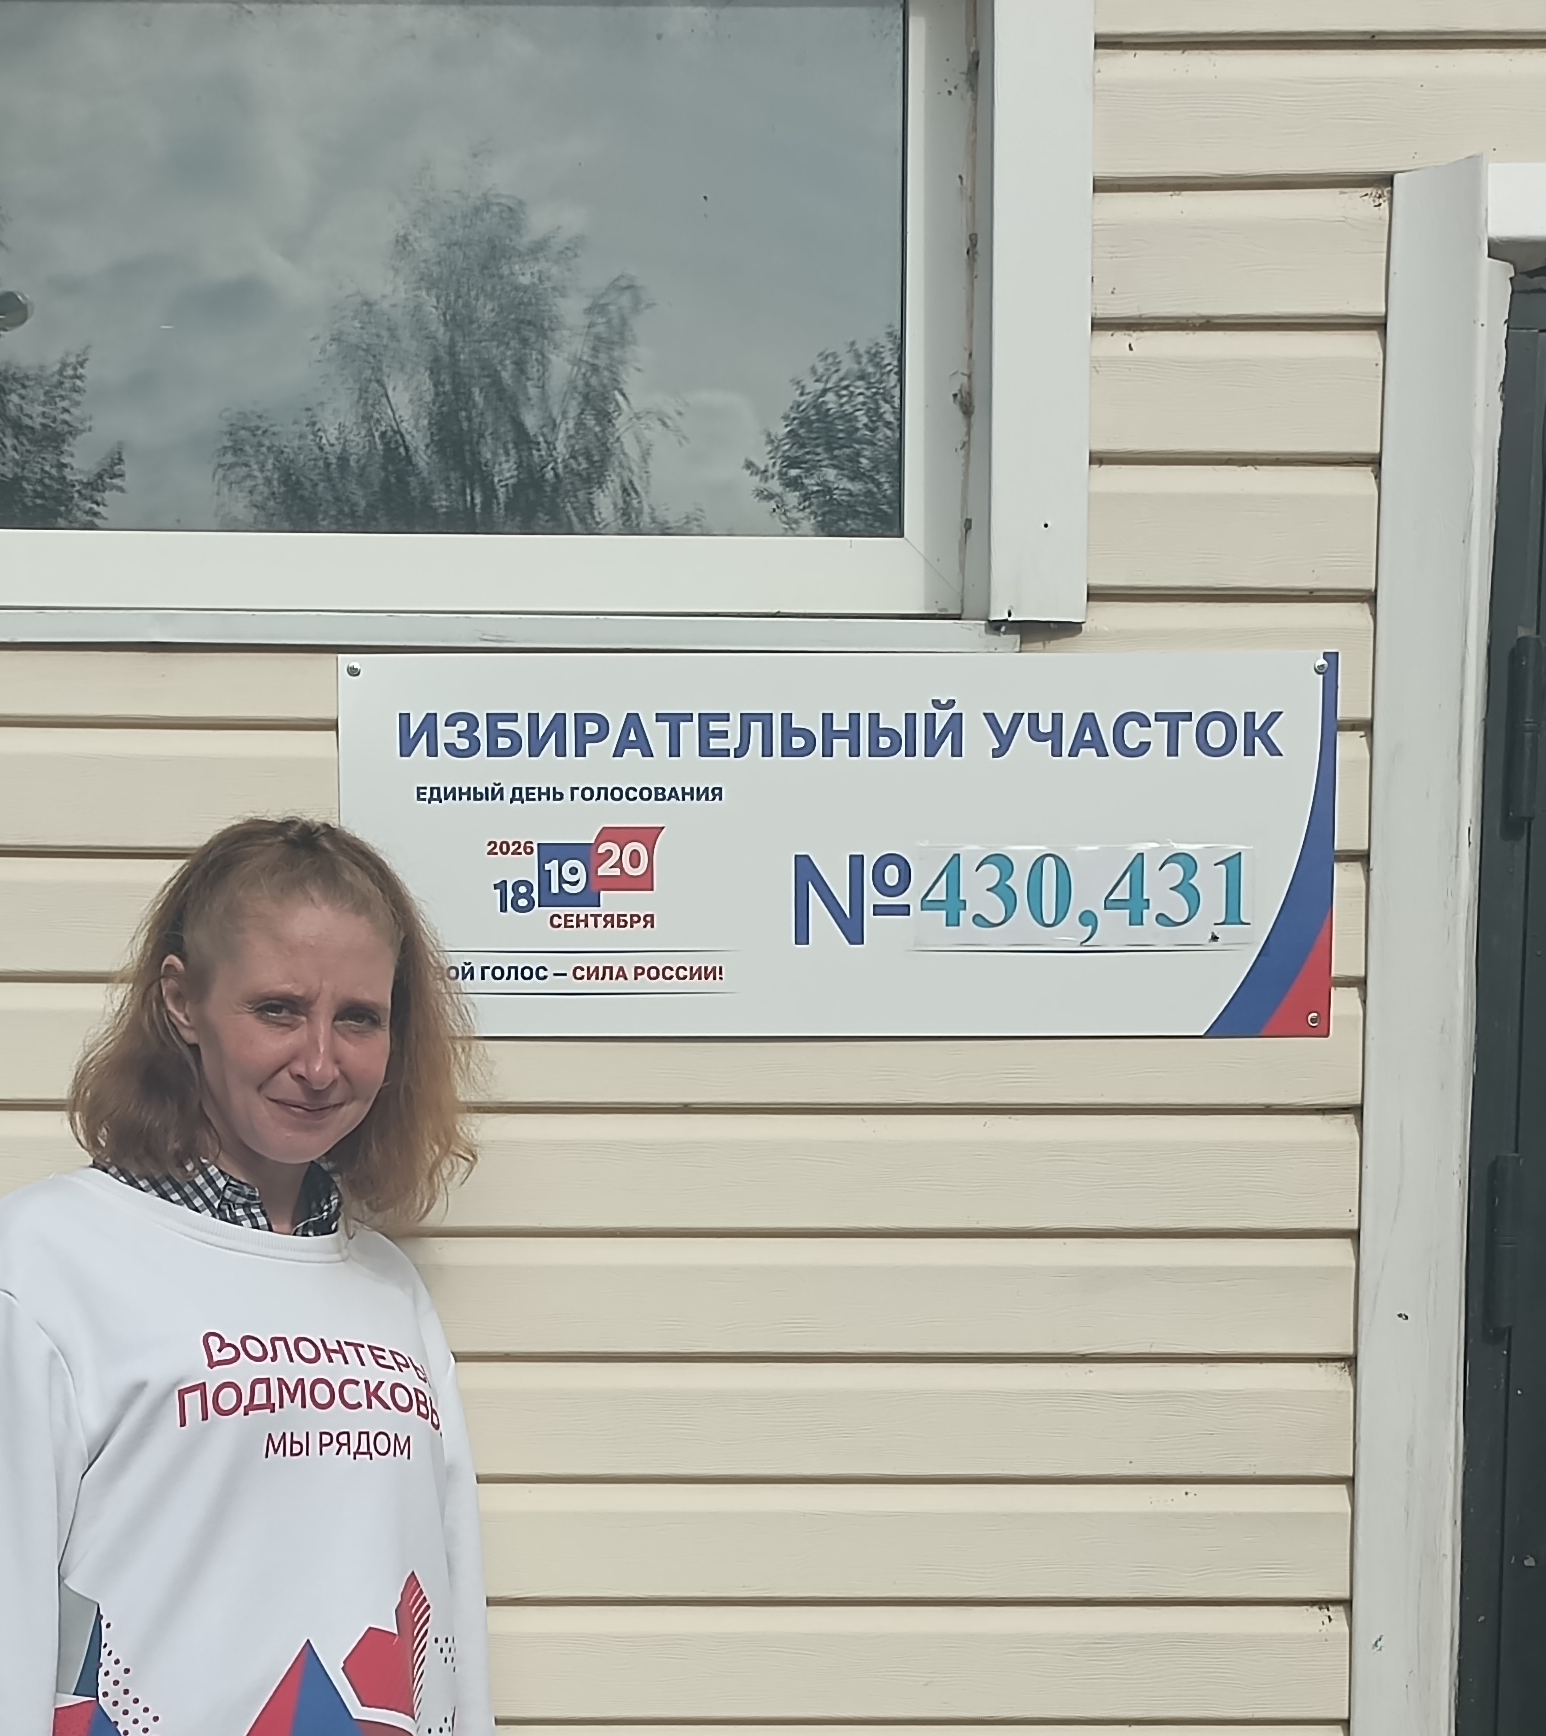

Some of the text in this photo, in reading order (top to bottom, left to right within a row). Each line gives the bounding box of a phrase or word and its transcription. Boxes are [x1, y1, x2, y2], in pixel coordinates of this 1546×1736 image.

[397, 699, 1285, 760] ИЗБИРАТЕЛЬНЫЙ УЧАСТОК
[416, 783, 723, 804] ЕДИНЫЙ ДЕНЬ ГОЛОСОВАНИЯ
[486, 841, 534, 855] 2026
[493, 842, 649, 913] 18 19 20
[550, 914, 655, 929] СЕНТЯБРЯ
[480, 966, 548, 981] ГОЛОС
[572, 966, 628, 981] СИЛА
[633, 966, 724, 981] РОССИИ!
[177, 1377, 442, 1437] ПОДМОСКОВЬ
[265, 1431, 412, 1460] МЫ РЯДОМ
